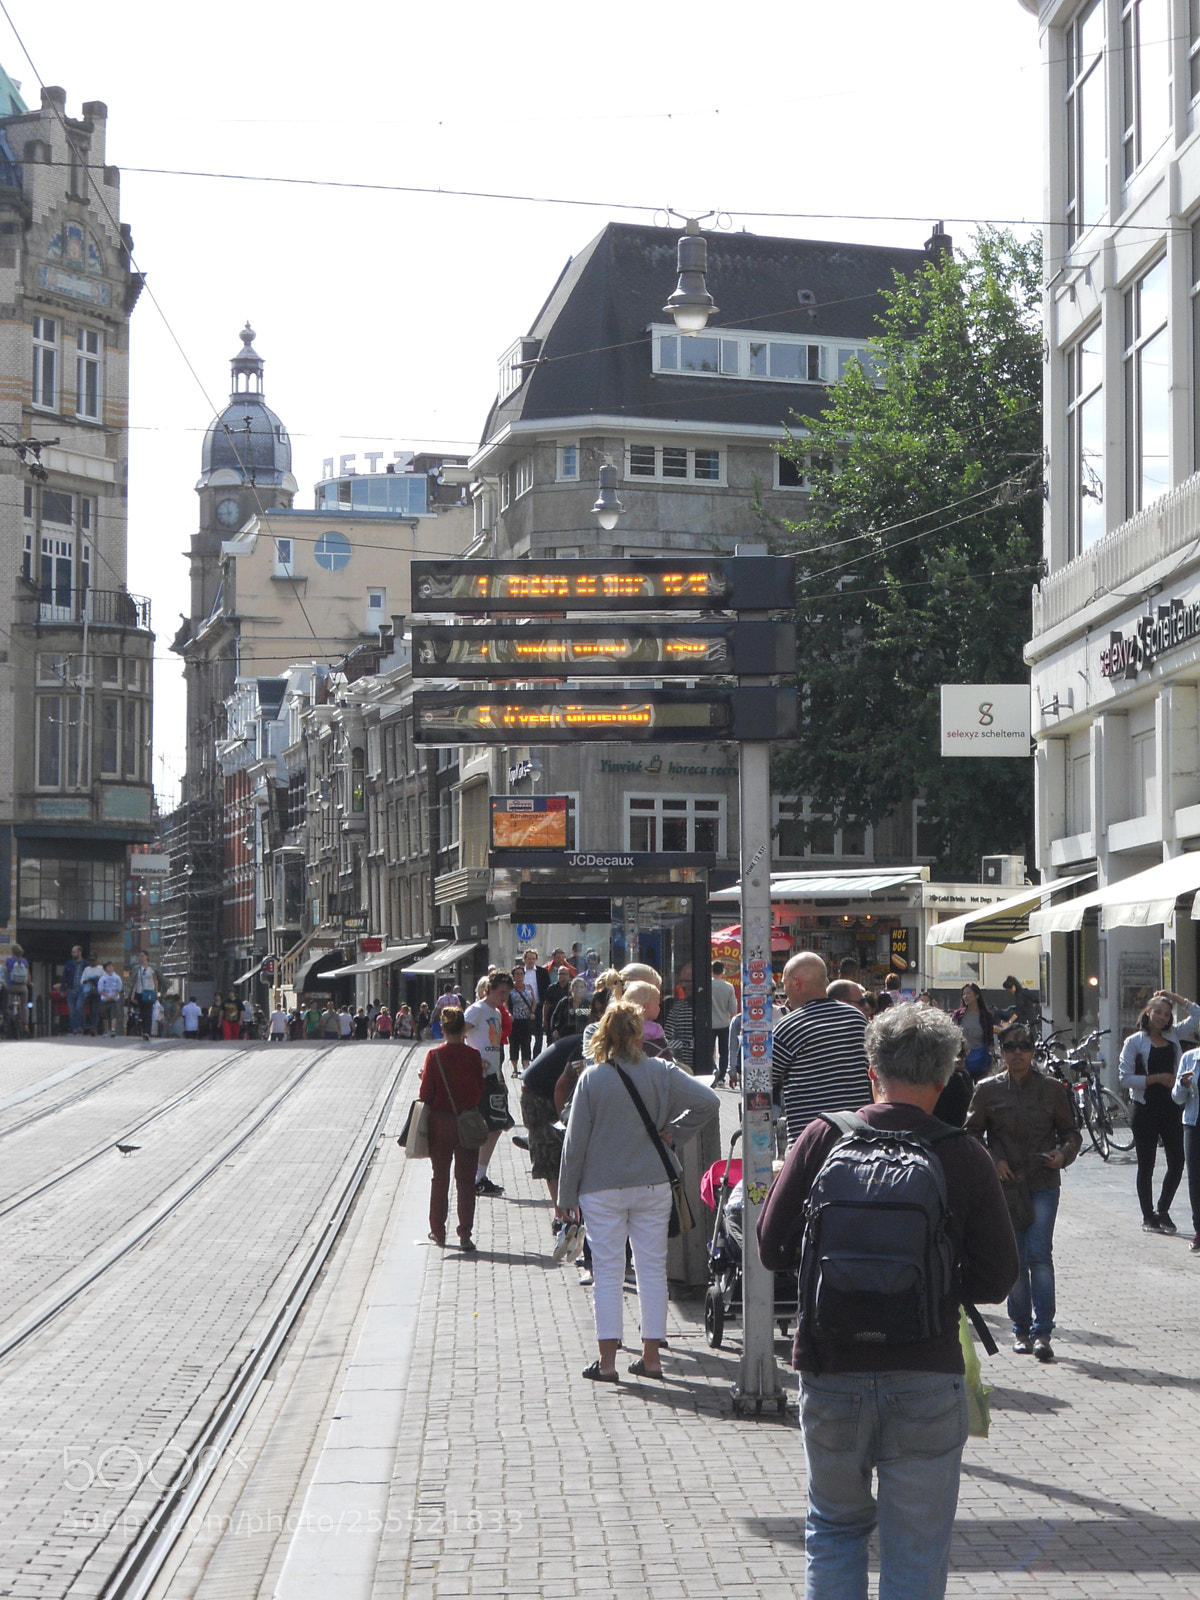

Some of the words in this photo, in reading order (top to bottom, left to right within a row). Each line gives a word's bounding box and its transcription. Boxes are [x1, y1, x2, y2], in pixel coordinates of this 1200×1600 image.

[322, 450, 415, 479] METZ
[947, 729, 979, 739] selexyz
[981, 728, 1025, 738] scheltema
[668, 761, 708, 776] horeca
[569, 854, 634, 867] JCDecaux
[892, 929, 906, 939] HOT
[892, 942, 907, 952] DOG
